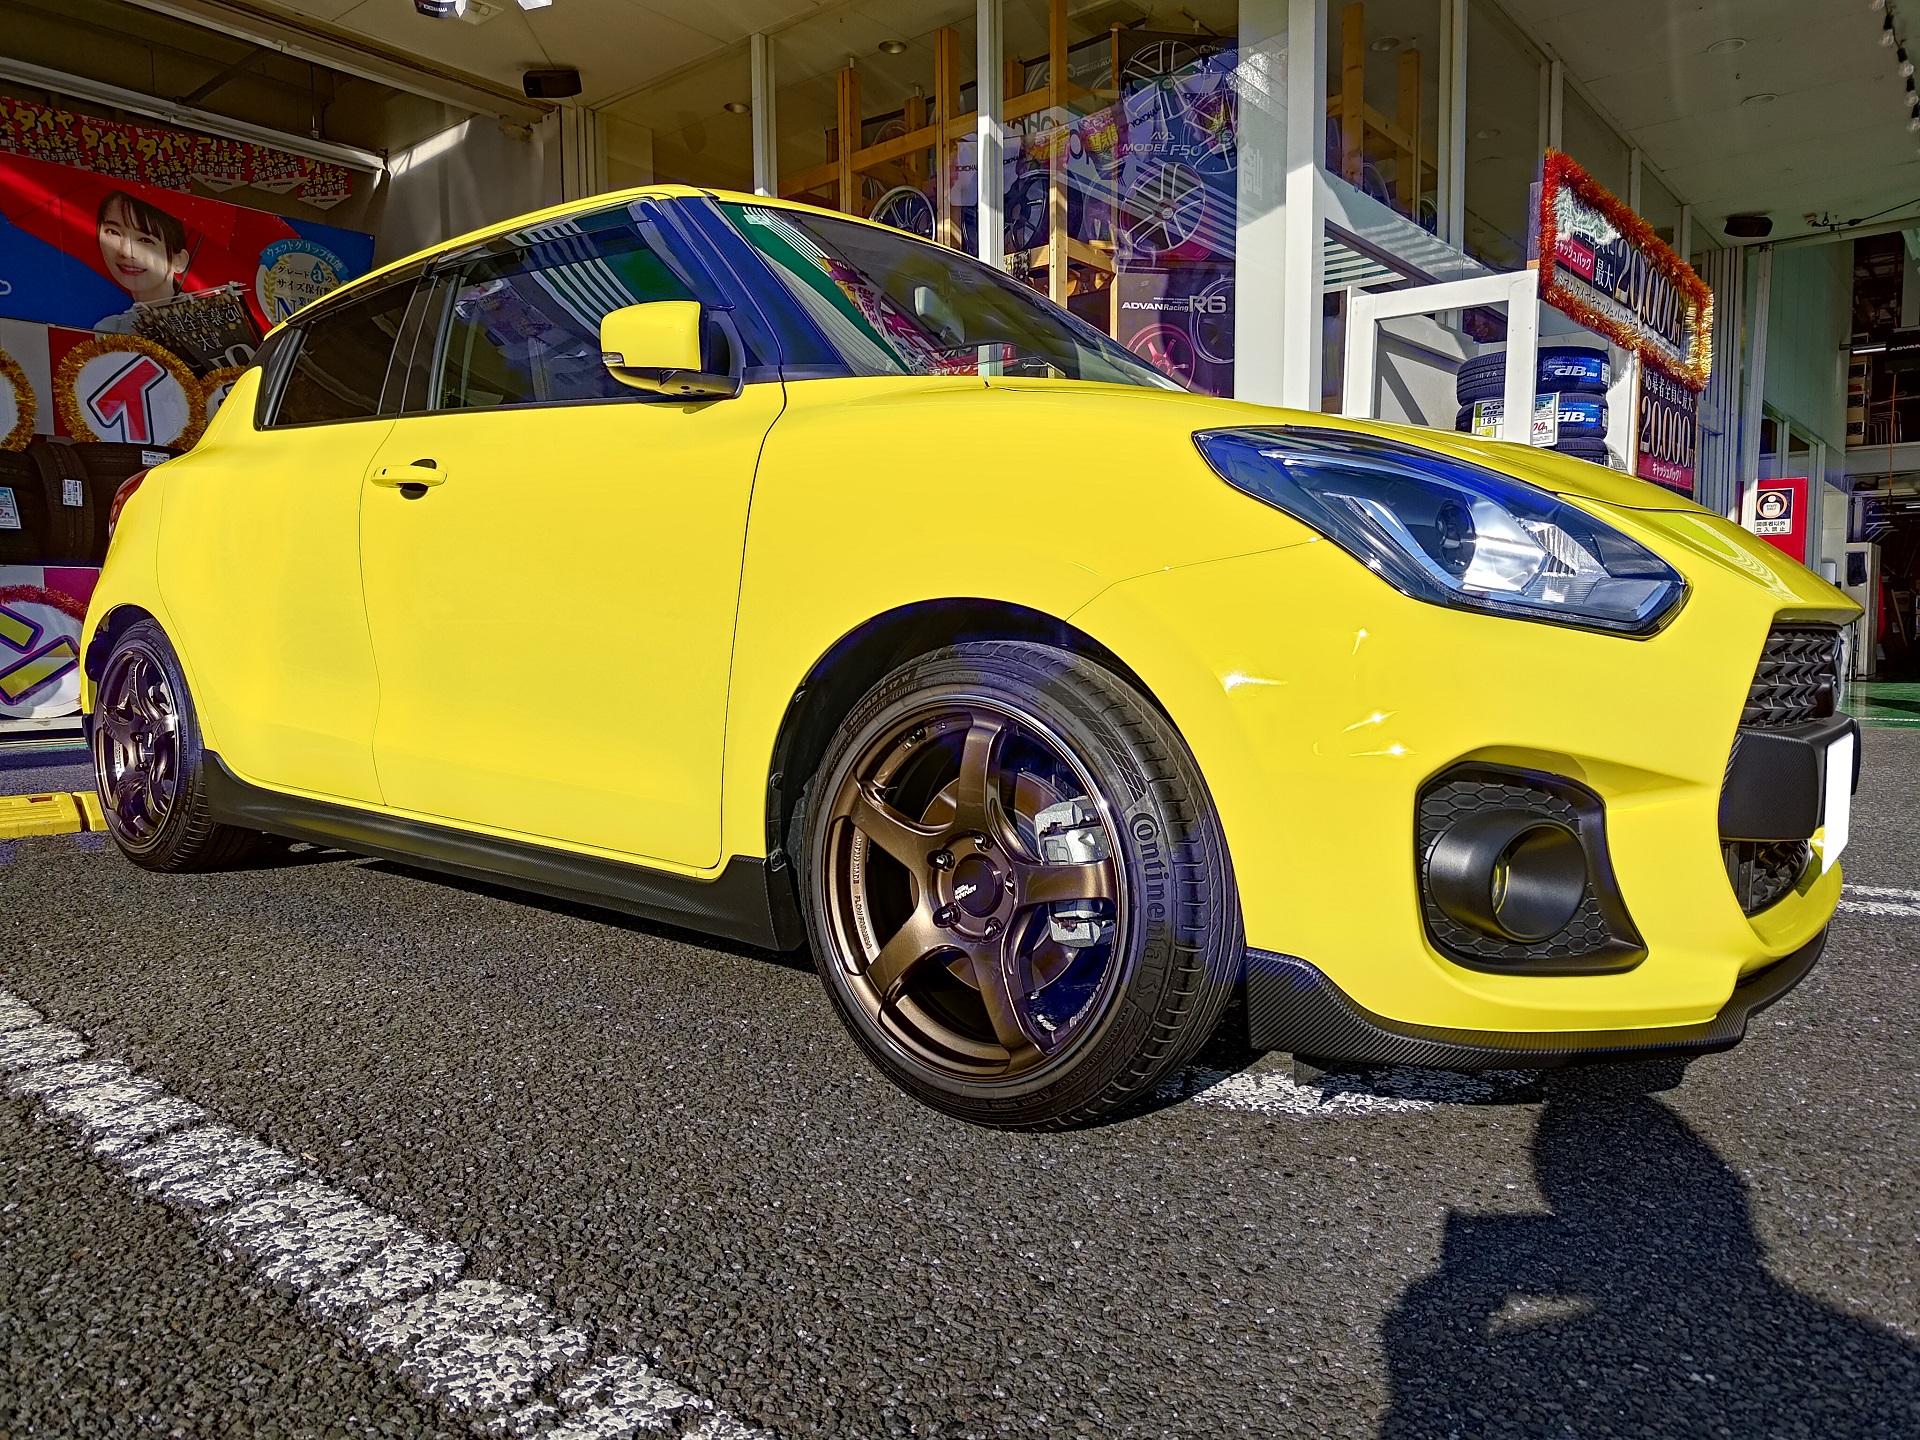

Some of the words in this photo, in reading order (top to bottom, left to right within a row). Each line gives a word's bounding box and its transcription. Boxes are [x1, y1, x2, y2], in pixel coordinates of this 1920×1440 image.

[13, 106, 75, 132] タイヤ
[82, 125, 134, 151] タイヤ
[136, 134, 192, 161] タイヤ
[1122, 143, 1168, 153] MODEL
[1169, 145, 1203, 157] F50
[266, 240, 344, 272] ウェットグリップ性能
[1595, 258, 1614, 291] 最大
[1122, 302, 1163, 311] ADVAN
[1163, 304, 1189, 313] Racing
[1189, 295, 1227, 314] R6
[1554, 366, 1587, 376] dB
[879, 687, 887, 699] R
[888, 679, 900, 692] 17
[901, 673, 911, 683] W
[1129, 812, 1169, 978] Continental
